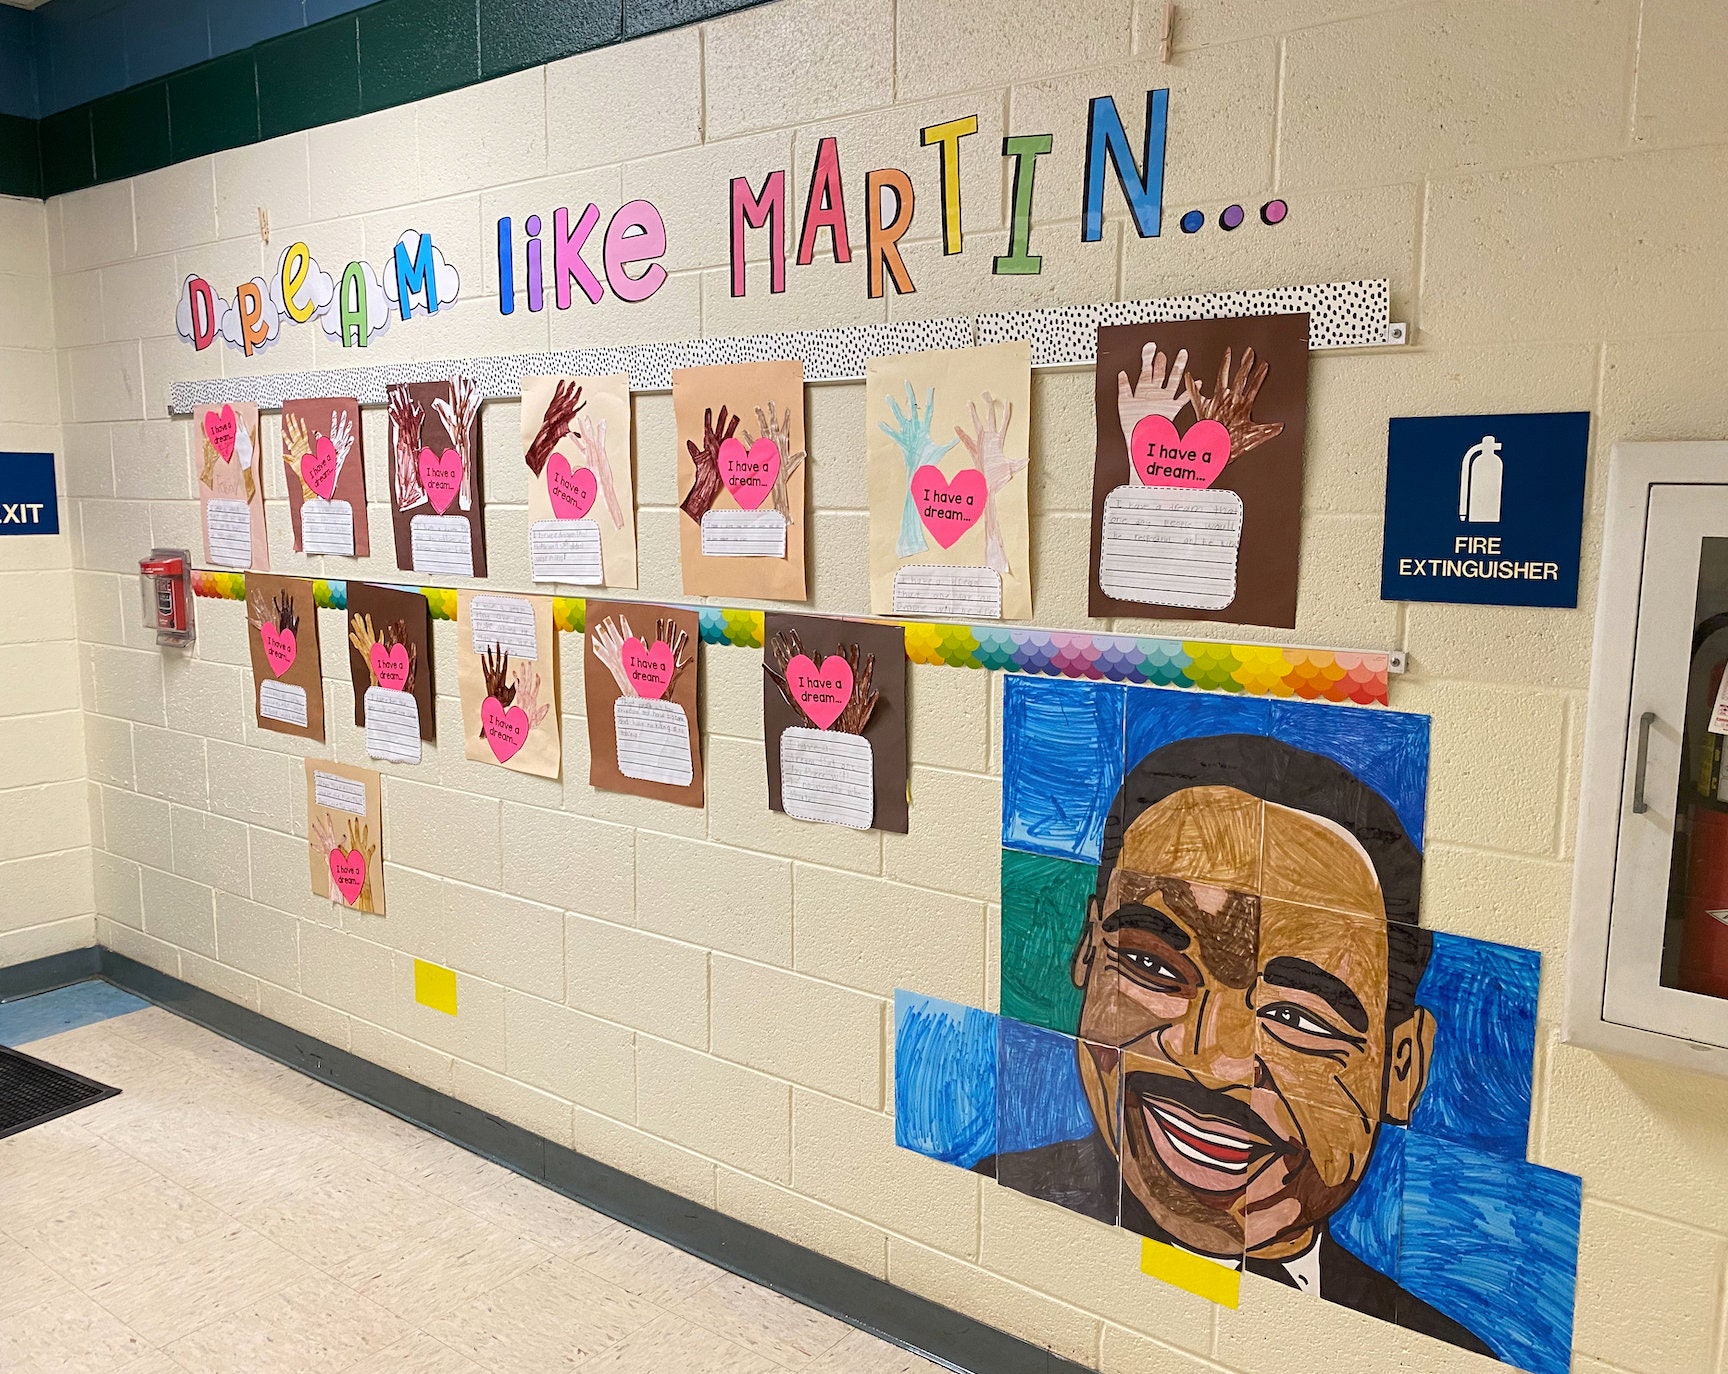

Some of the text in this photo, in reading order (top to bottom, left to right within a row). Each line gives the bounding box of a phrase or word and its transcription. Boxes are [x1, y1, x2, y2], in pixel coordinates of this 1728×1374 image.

[211, 426, 215, 435] I
[215, 424, 228, 434] have
[214, 433, 234, 444] dream...
[1146, 443, 1212, 463] I have a
[309, 471, 314, 479] I
[312, 459, 327, 476] have
[426, 467, 455, 478] I have a
[728, 461, 769, 472] I have a
[1146, 462, 1206, 482] dream...
[314, 468, 334, 488] dream...
[428, 480, 454, 490] dream...
[554, 472, 587, 499] I have a
[729, 475, 768, 487] dream...
[552, 486, 582, 511] dream...
[923, 489, 974, 506] I have a
[924, 505, 971, 522] dream...
[1454, 536, 1502, 555] FIRE
[1399, 558, 1559, 580] EXTINGUISHER
[267, 636, 291, 653] I have a
[268, 647, 291, 663] dream...
[377, 660, 403, 670] I have a
[630, 656, 666, 671] I have a
[379, 670, 403, 680] dream...
[632, 669, 666, 684] dream...
[798, 676, 843, 689] I have a
[801, 691, 842, 704] dream...
[489, 714, 520, 735] I have a
[489, 727, 518, 746] dream...
[336, 865, 360, 875] I have a
[337, 875, 360, 885] dream...
